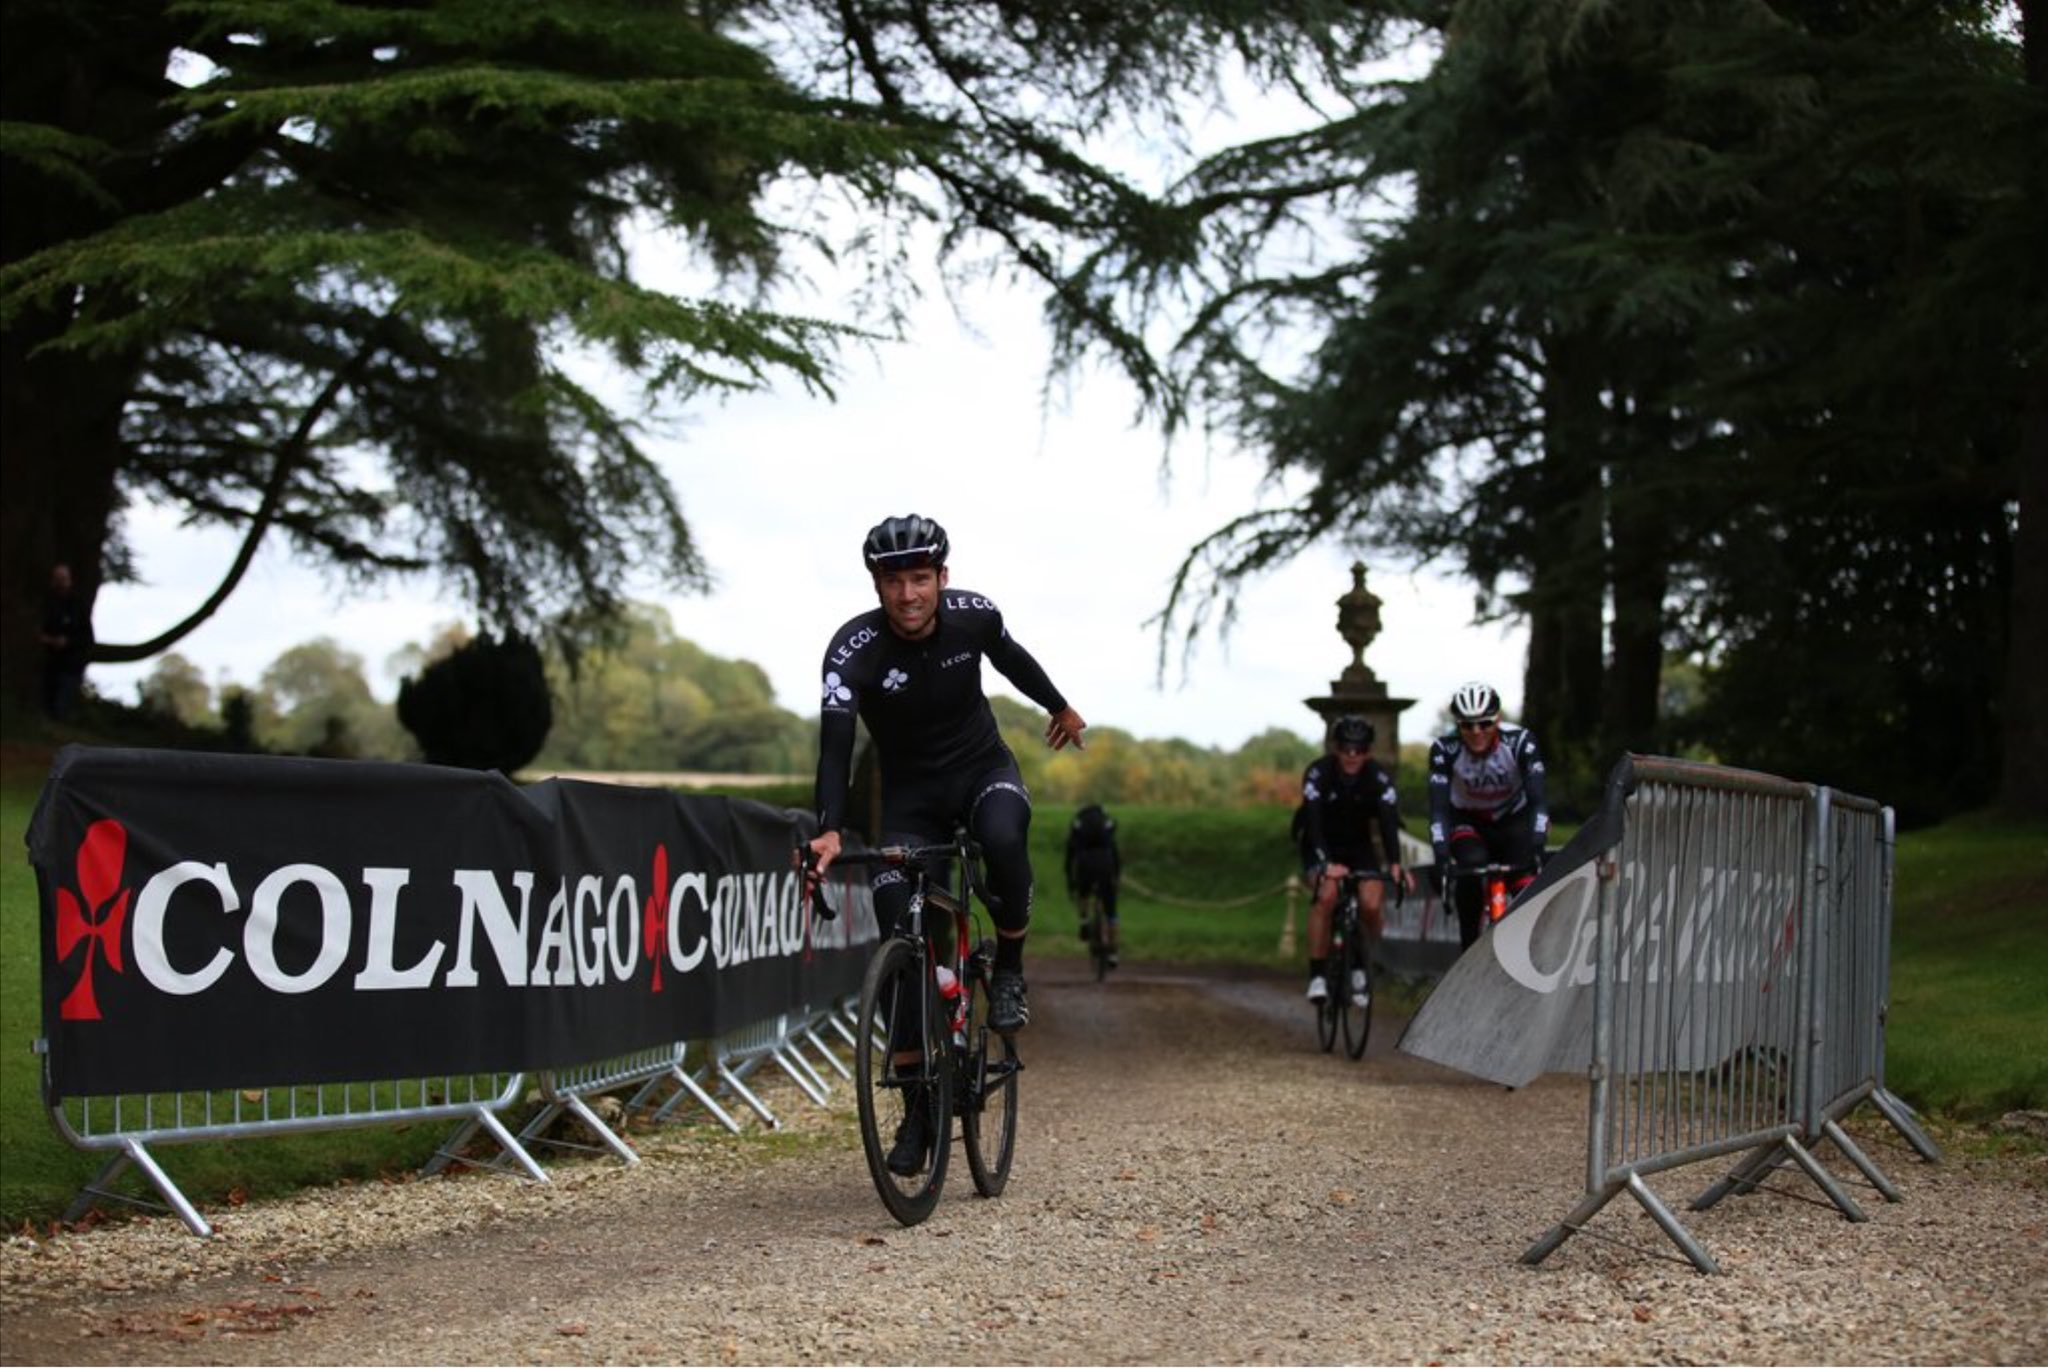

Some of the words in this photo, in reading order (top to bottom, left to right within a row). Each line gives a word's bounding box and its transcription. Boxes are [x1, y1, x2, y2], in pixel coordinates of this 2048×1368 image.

[946, 597, 970, 609] LE
[972, 597, 997, 611] CO
[831, 645, 853, 666] LE
[849, 627, 878, 649] COL
[954, 651, 972, 663] COL
[132, 861, 641, 996] COLNAGO
